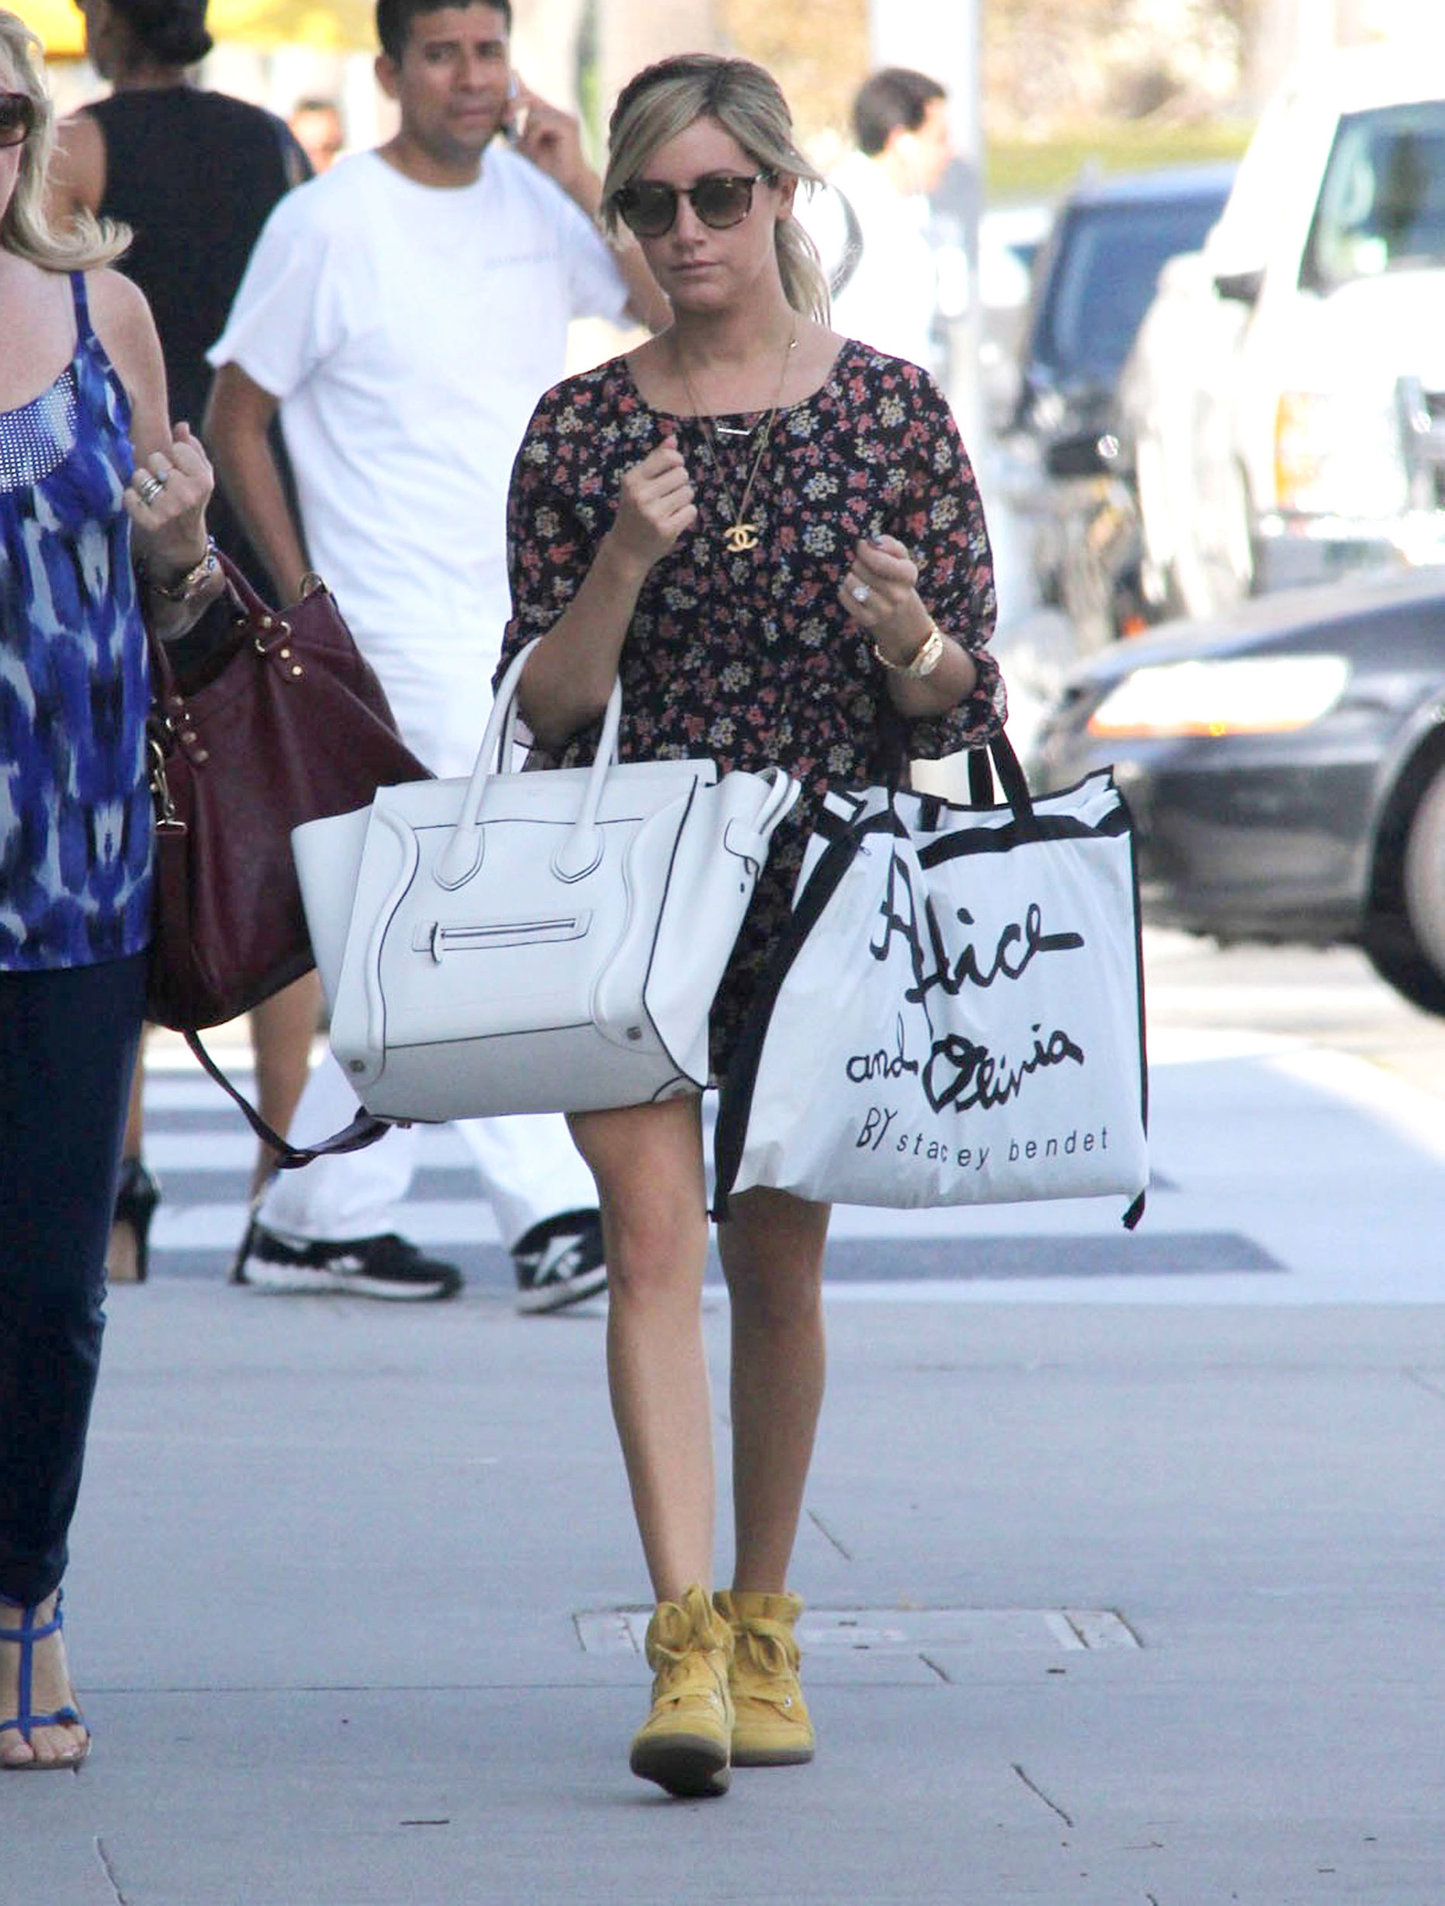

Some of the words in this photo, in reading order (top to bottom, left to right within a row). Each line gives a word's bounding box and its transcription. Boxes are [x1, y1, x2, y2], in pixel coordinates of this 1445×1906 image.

[870, 843, 1085, 1034] Alice
[846, 1011, 918, 1083] and
[922, 1023, 1085, 1114] Olivia
[856, 1107, 898, 1151] BY
[896, 1132, 989, 1170] stacey
[1008, 1126, 1108, 1162] bendet
